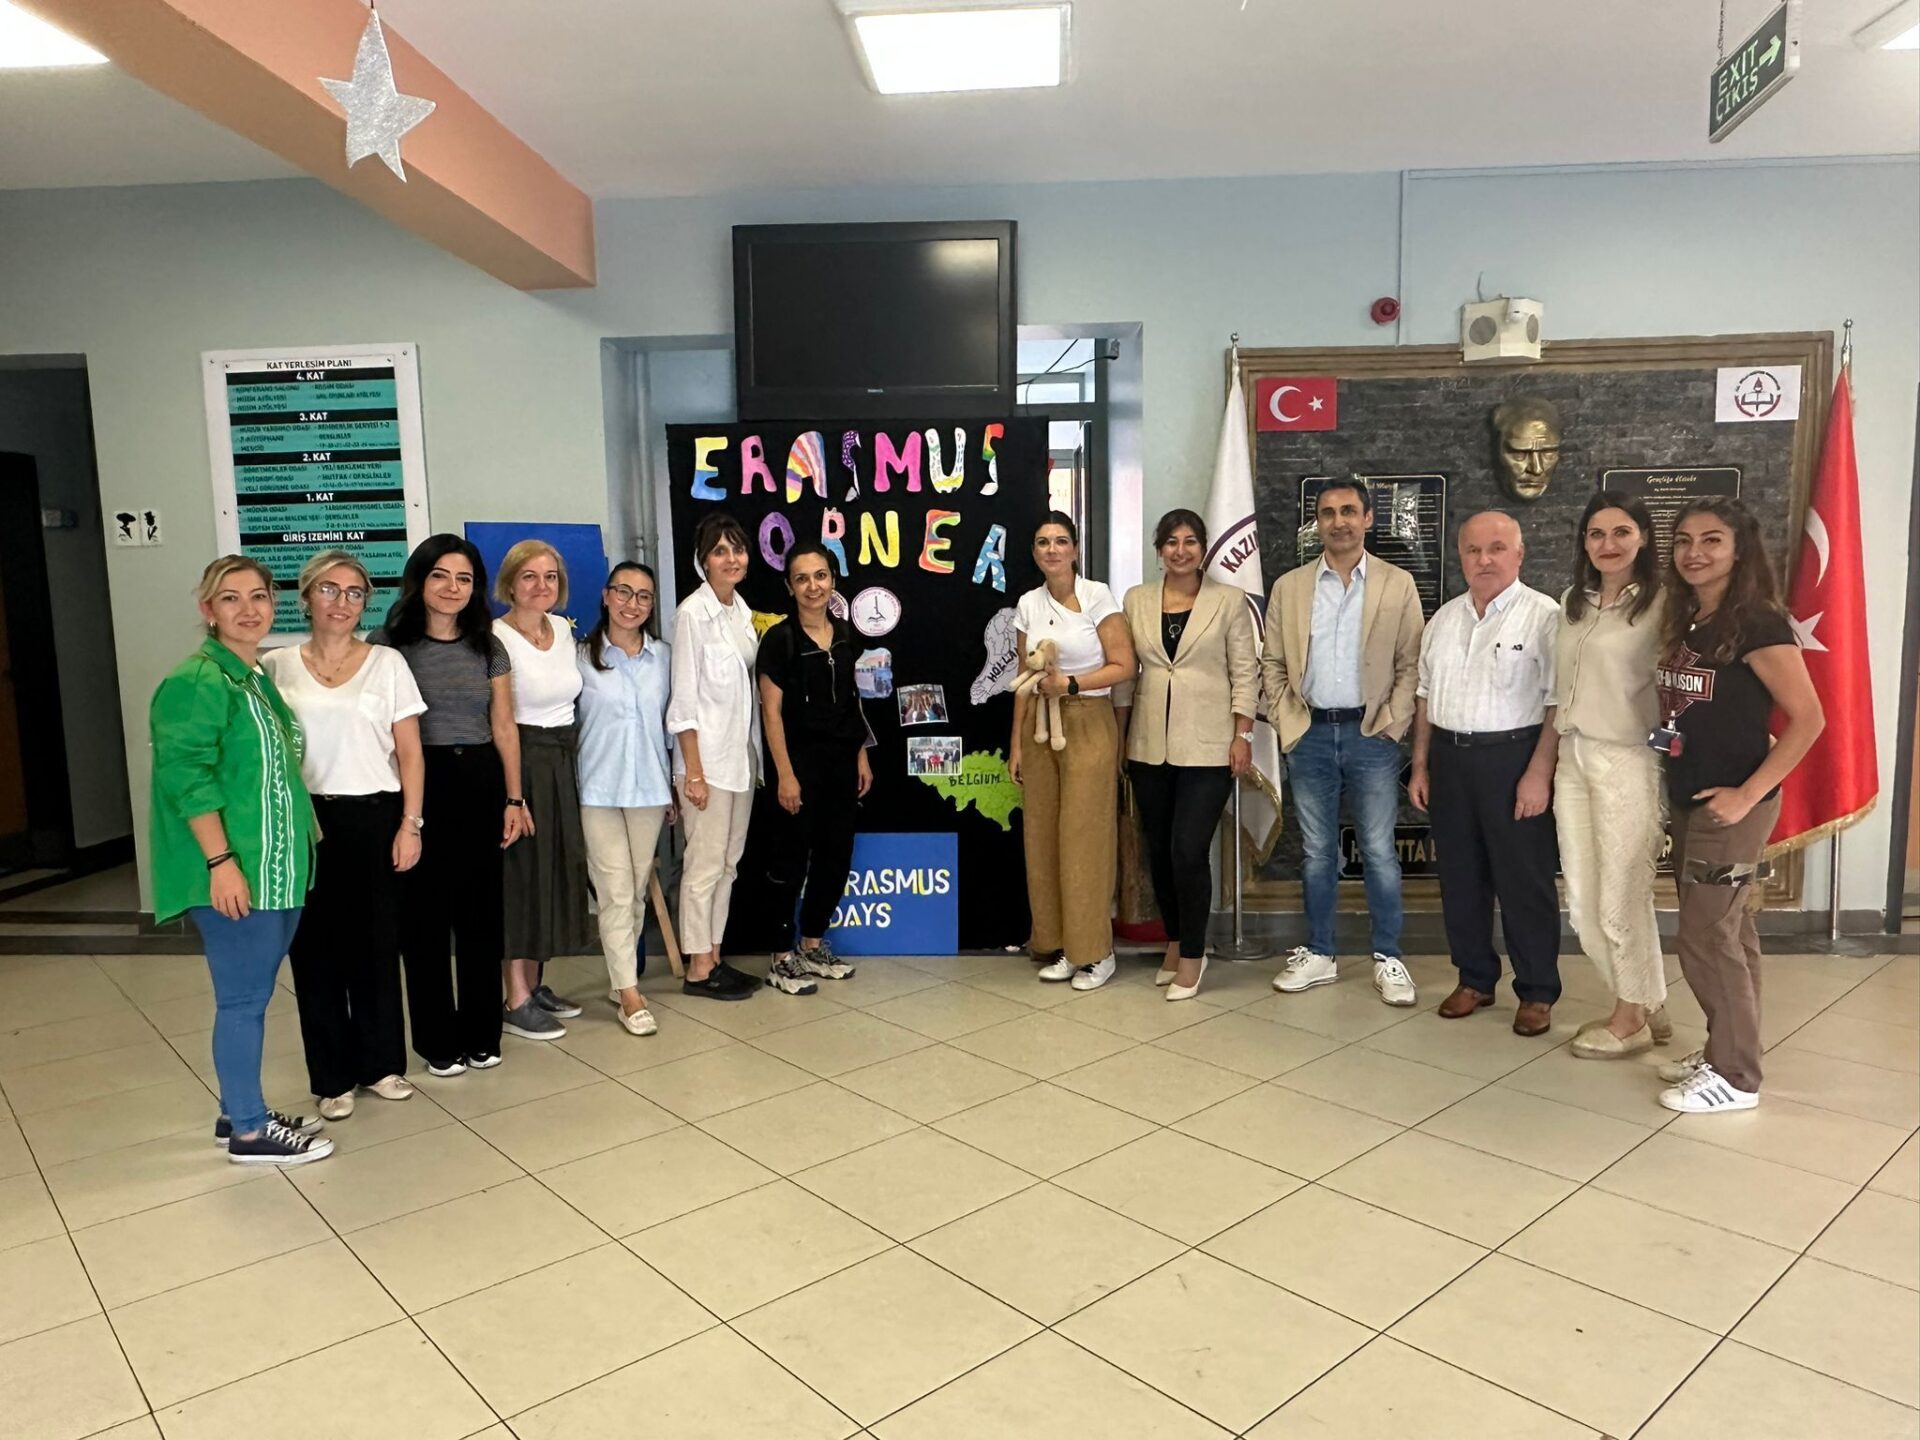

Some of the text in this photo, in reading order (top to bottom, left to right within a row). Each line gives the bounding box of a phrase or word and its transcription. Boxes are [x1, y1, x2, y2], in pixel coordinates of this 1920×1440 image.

[1718, 39, 1758, 98] EXIT
[1715, 67, 1759, 125] ÇIKIŞ
[306, 370, 326, 380] KAT
[299, 412, 328, 421] 3. KAT
[302, 452, 332, 462] 2. KAT
[691, 424, 1004, 504] ERASMUS
[306, 492, 334, 502] 1. KAT
[346, 531, 365, 541] KAT
[757, 508, 1006, 593] ORNER
[948, 773, 1000, 787] BELGIUM
[844, 868, 951, 897] RASMUS
